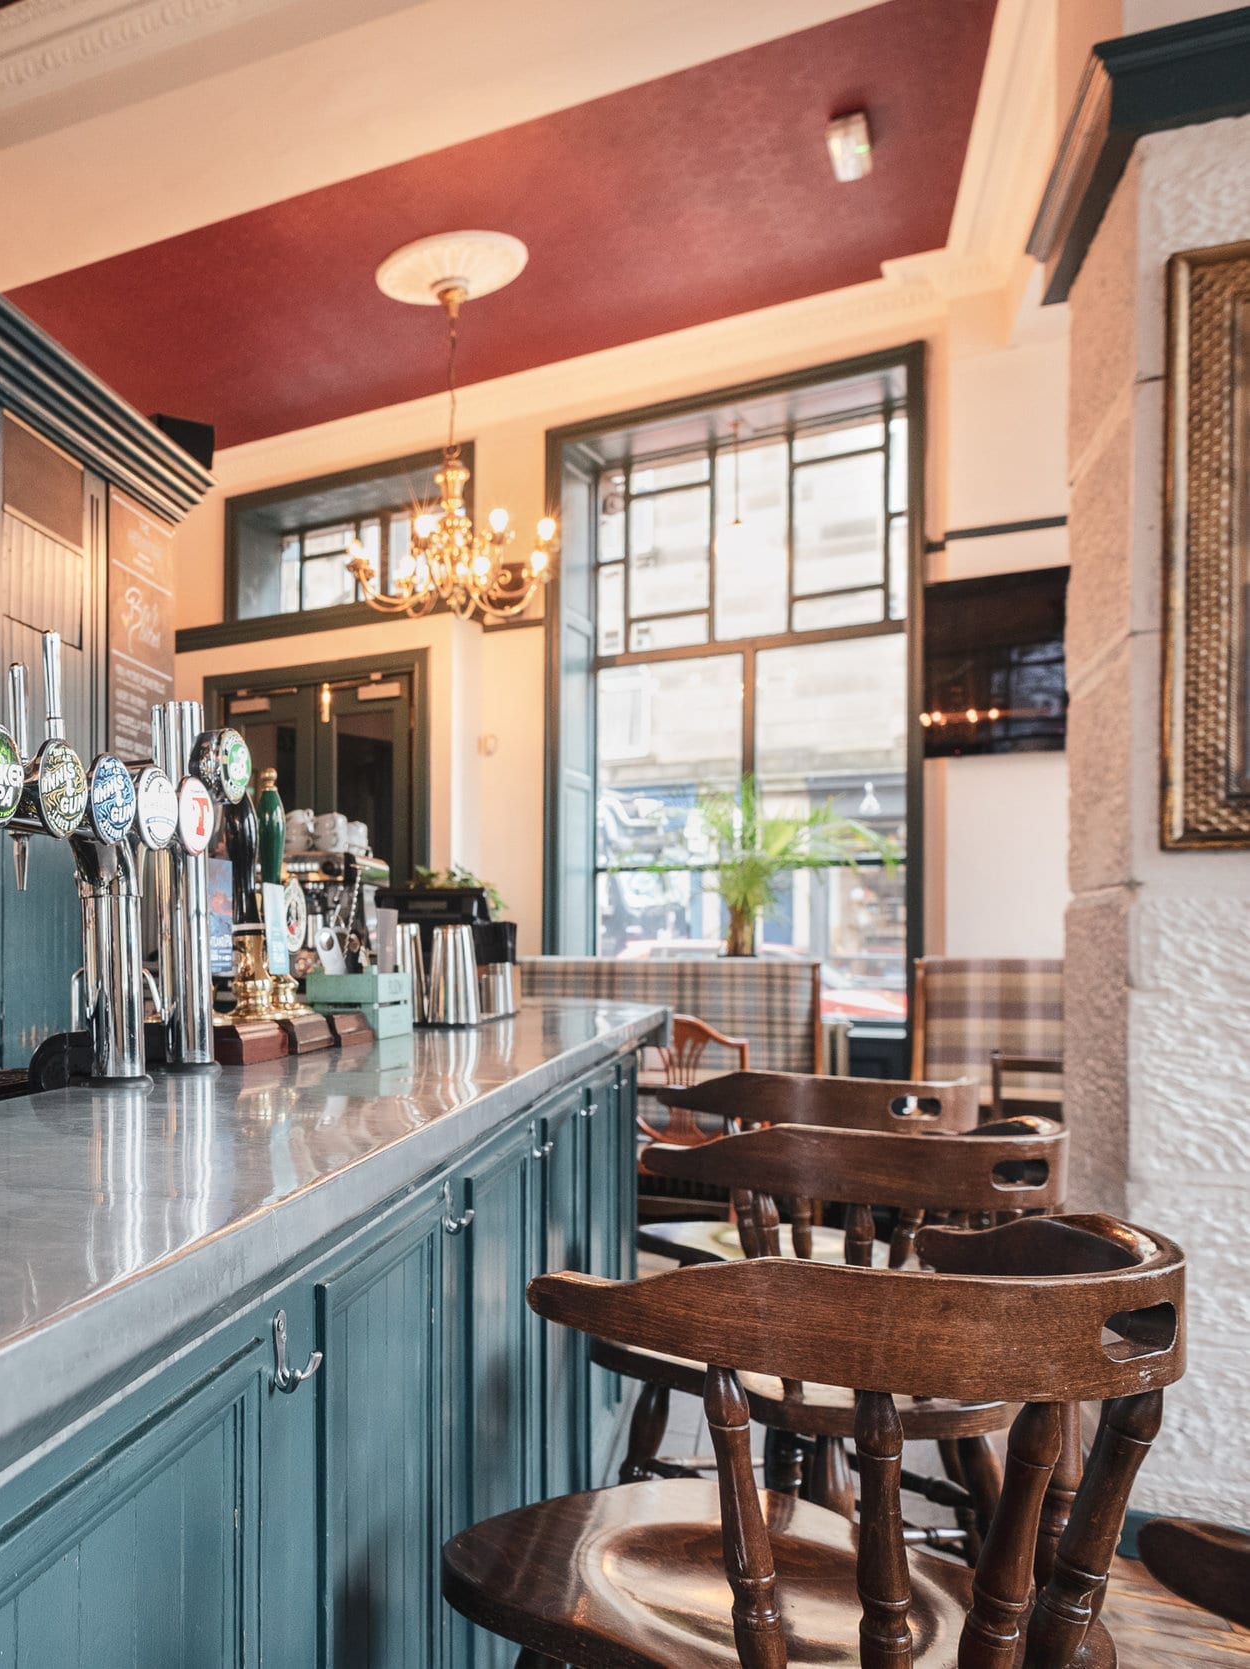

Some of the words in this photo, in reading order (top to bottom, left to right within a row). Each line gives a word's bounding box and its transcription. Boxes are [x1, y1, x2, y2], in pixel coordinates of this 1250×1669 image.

[42, 762, 76, 795] INNIS
[93, 774, 125, 804] INNIS
[60, 791, 86, 815] GUN
[110, 804, 135, 823] GUN
